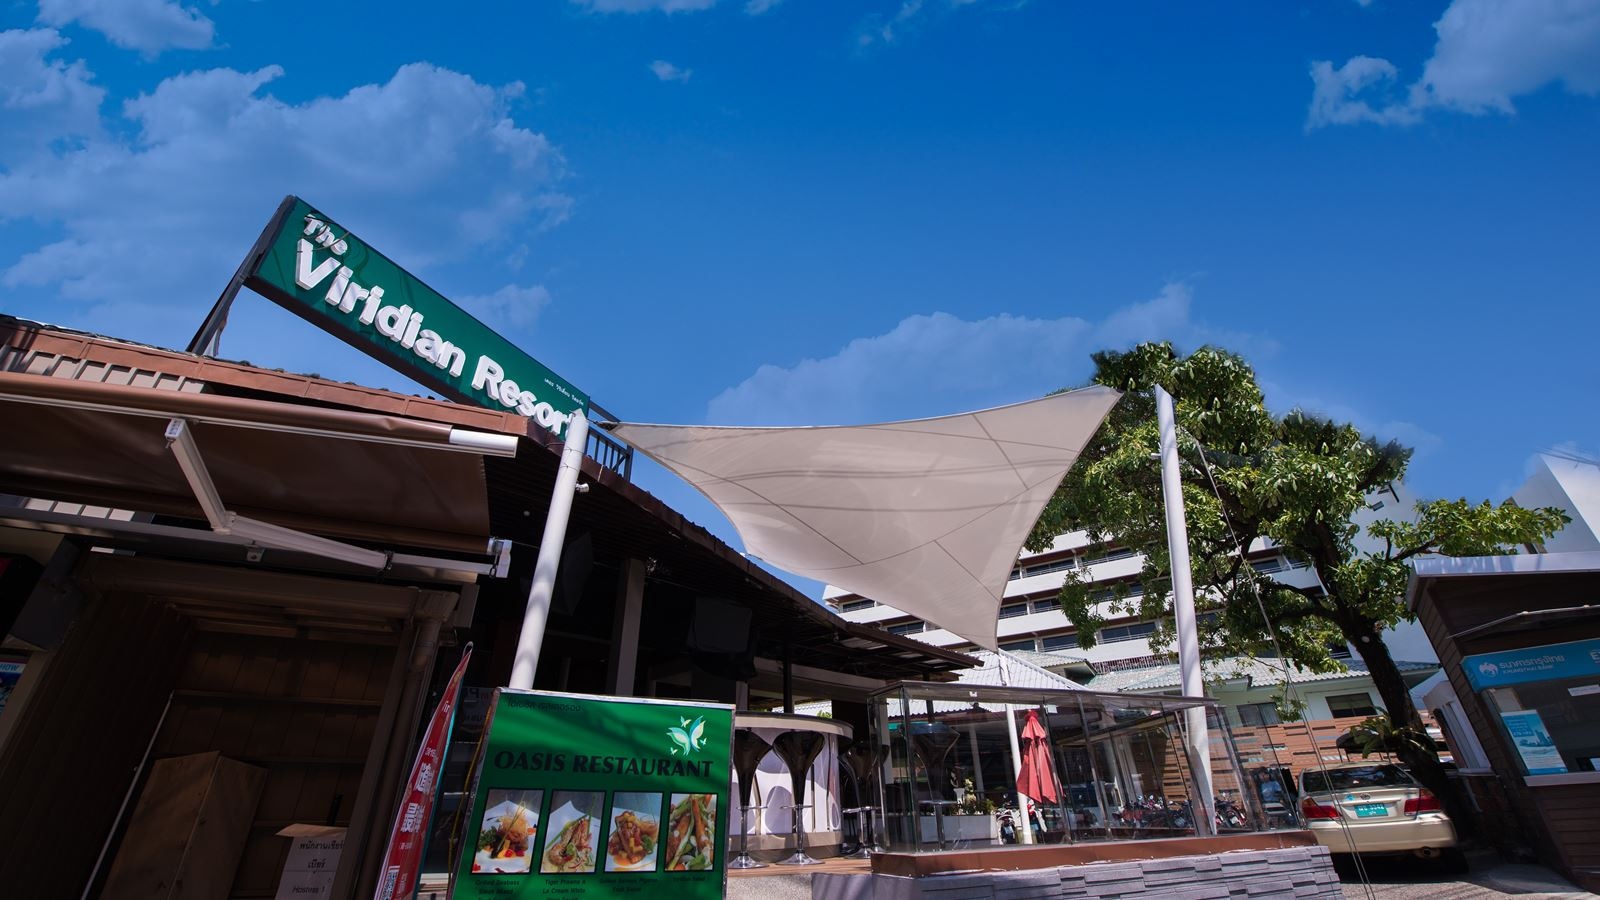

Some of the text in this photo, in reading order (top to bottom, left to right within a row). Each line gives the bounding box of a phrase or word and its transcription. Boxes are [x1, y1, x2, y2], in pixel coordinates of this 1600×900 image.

[303, 213, 348, 255] The
[295, 238, 467, 378] Viridian
[494, 751, 713, 778] OASIS RESTAURANT
